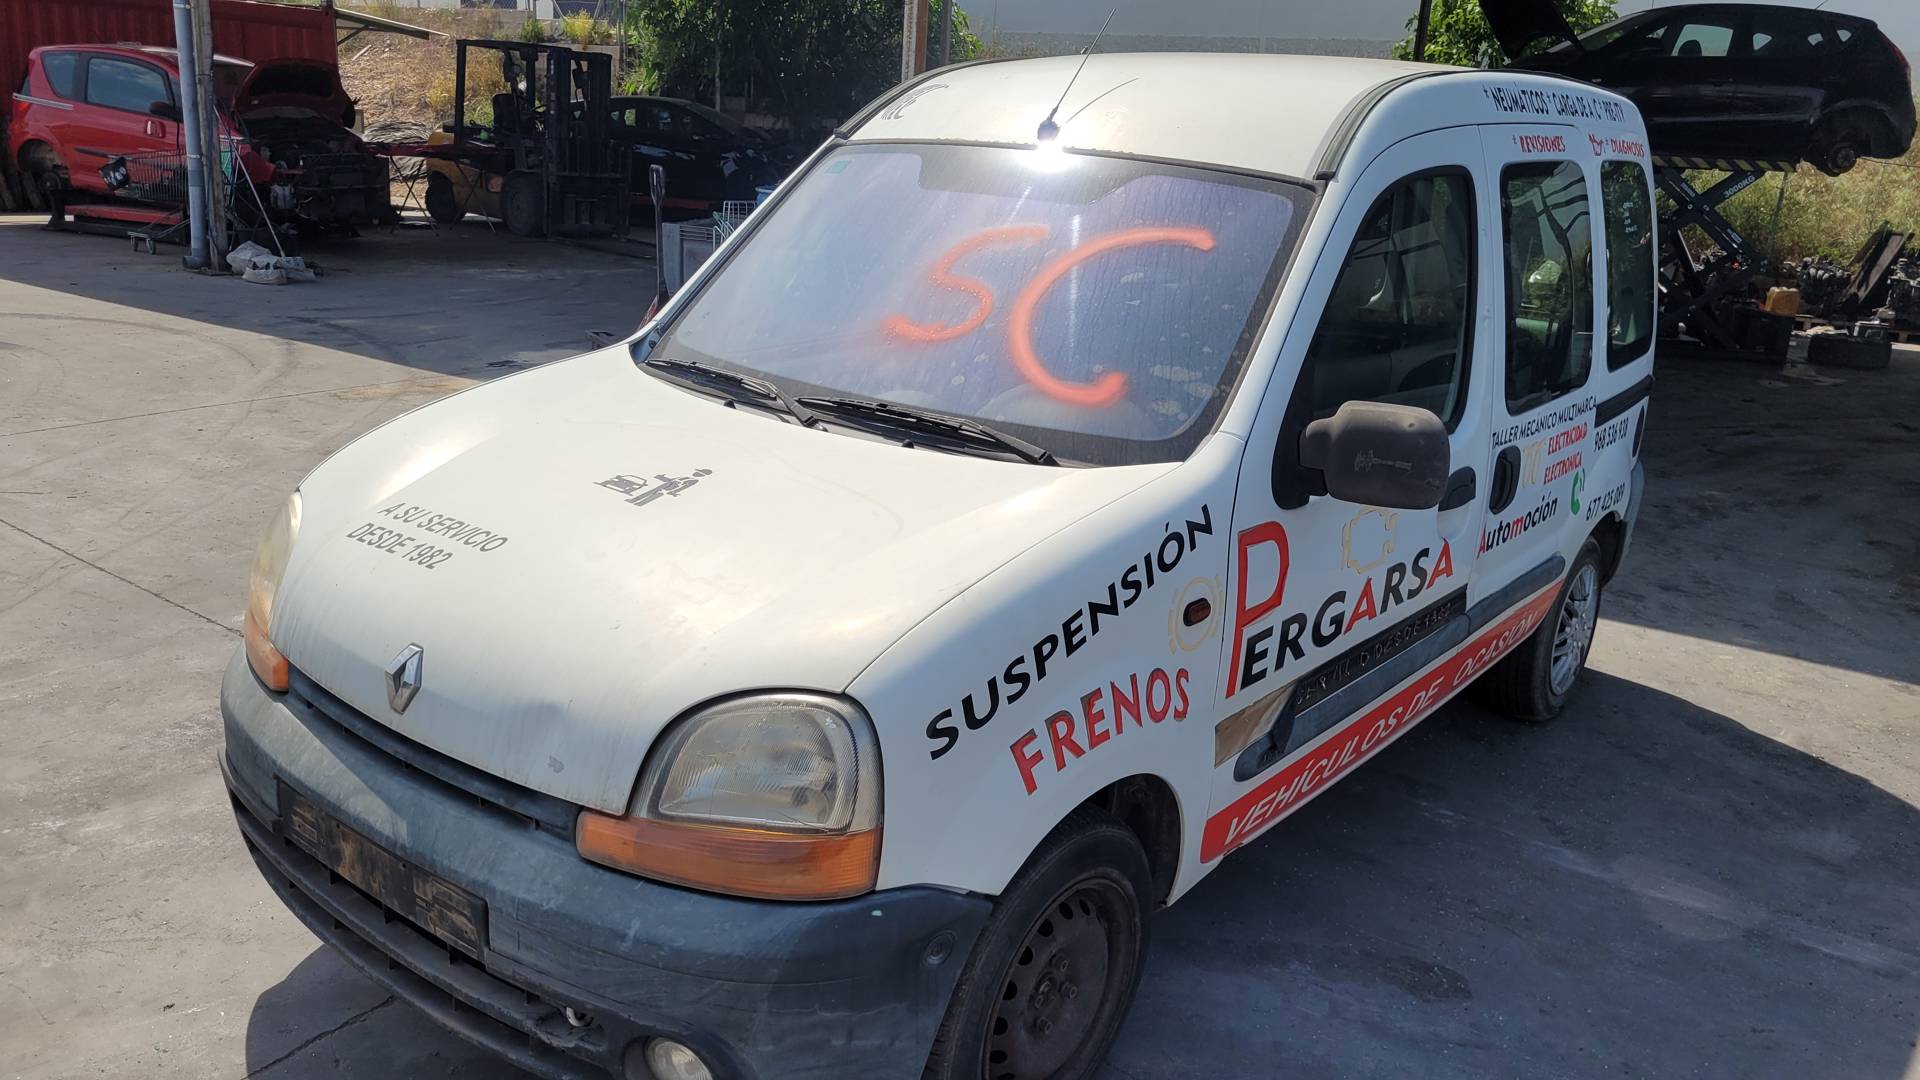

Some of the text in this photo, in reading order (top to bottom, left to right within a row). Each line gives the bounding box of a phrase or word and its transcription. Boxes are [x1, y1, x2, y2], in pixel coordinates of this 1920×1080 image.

[1519, 135, 1566, 153] REVISIONES
[1610, 137, 1645, 158] DIAGNOSIS
[1492, 424, 1521, 449] TALLER
[1557, 395, 1597, 425] MULTIMARCA
[1547, 421, 1588, 456] ELECTRICIDAD
[346, 522, 454, 570] DESDE 1982
[377, 502, 509, 553] A SU SERVICIO
[1478, 491, 1559, 557] Automoción
[925, 503, 1213, 761] SUSPENSIÓN
[1225, 520, 1454, 699] PERGARSA
[1009, 667, 1190, 796] FRENOS
[1224, 706, 1404, 846] VEHÍCULOS
[1402, 675, 1445, 724] DE
